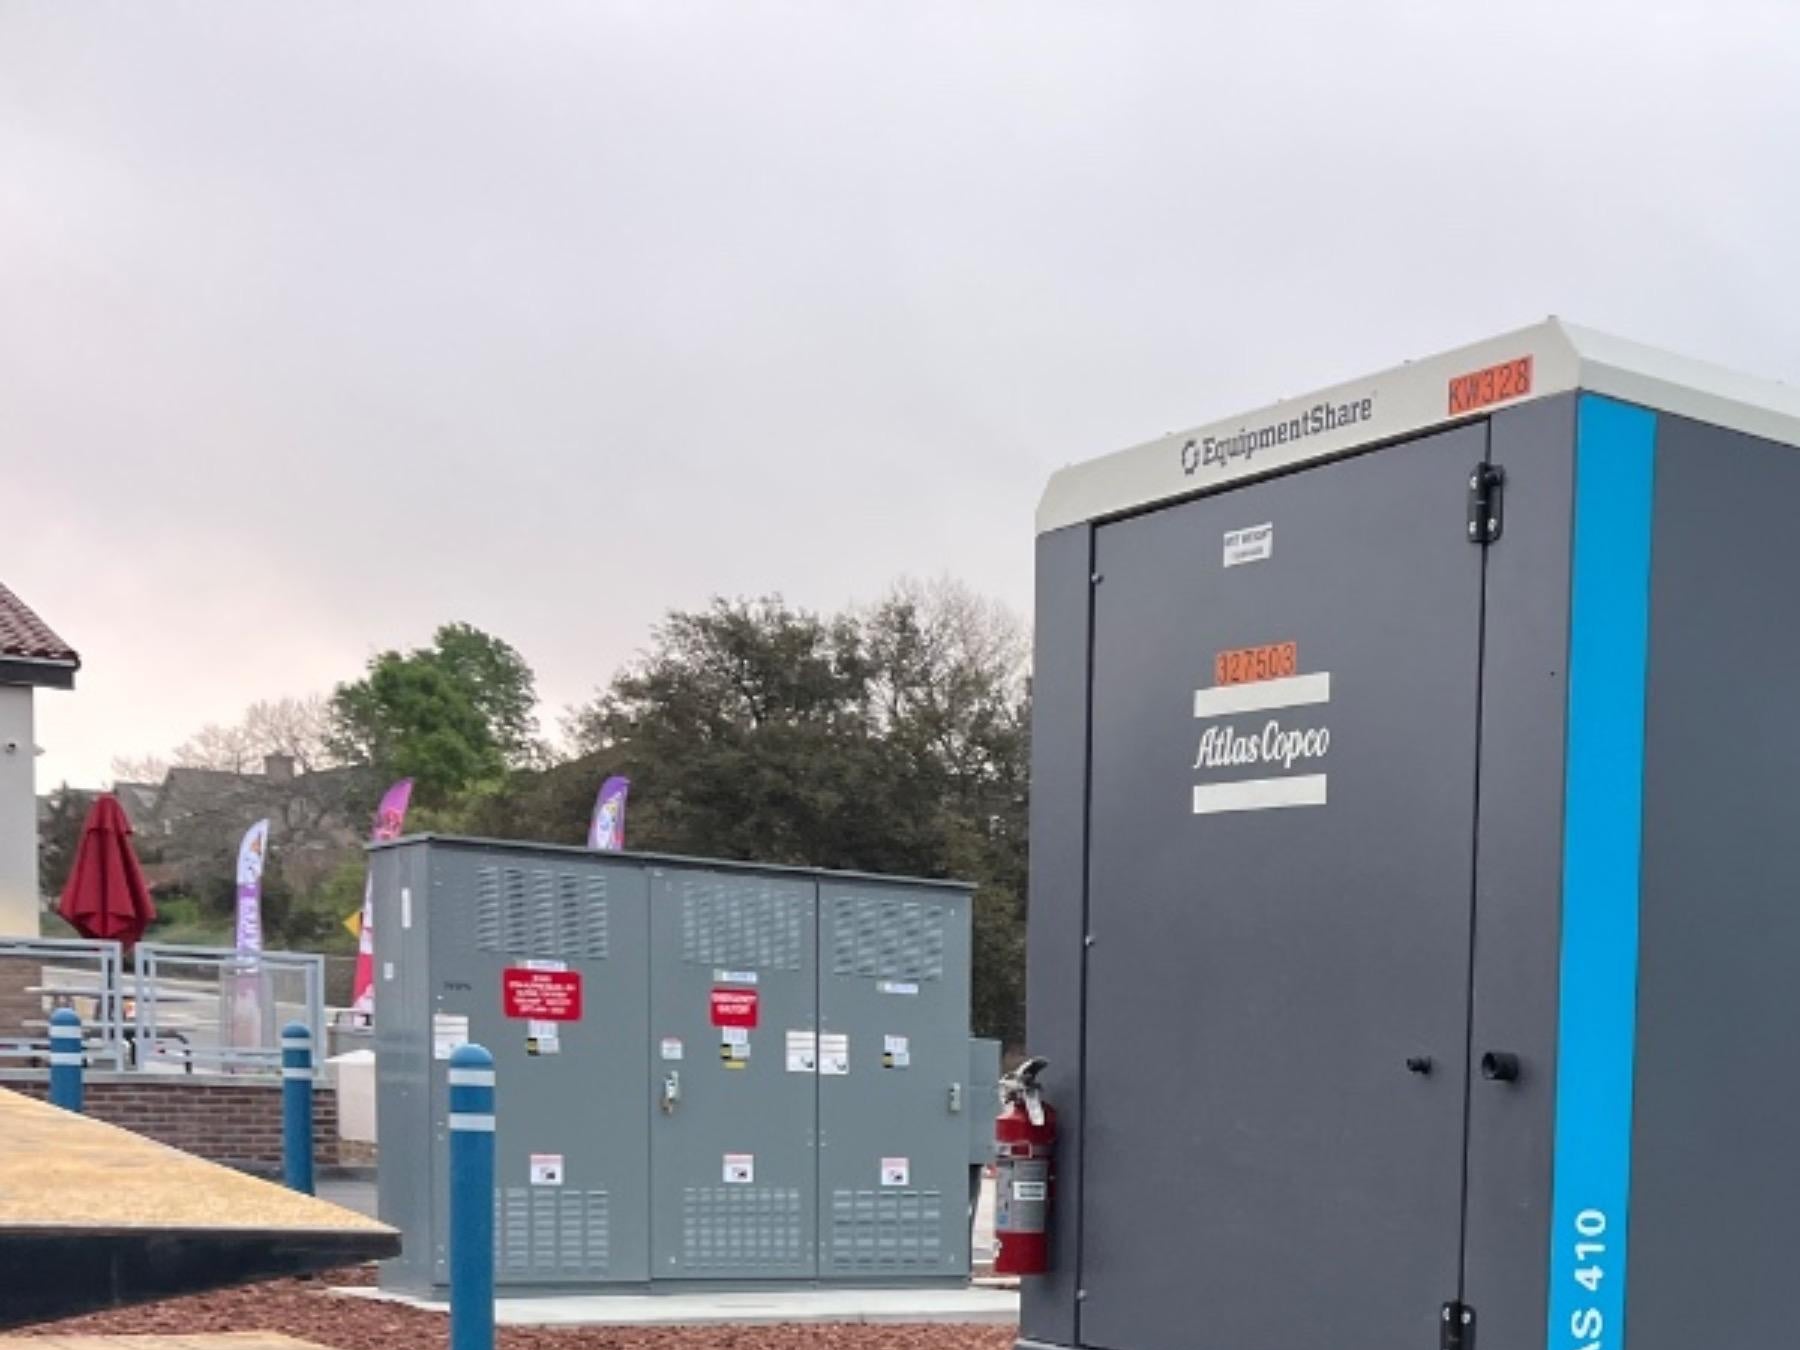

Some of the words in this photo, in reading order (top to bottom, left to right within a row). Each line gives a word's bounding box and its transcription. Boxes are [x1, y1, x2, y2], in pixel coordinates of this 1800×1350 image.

[1449, 357, 1531, 413] KW328
[1202, 398, 1373, 467] EquipmentShare
[1193, 725, 1261, 769] Atlas
[1262, 719, 1330, 769] Copco
[1574, 1208, 1607, 1291] 410
